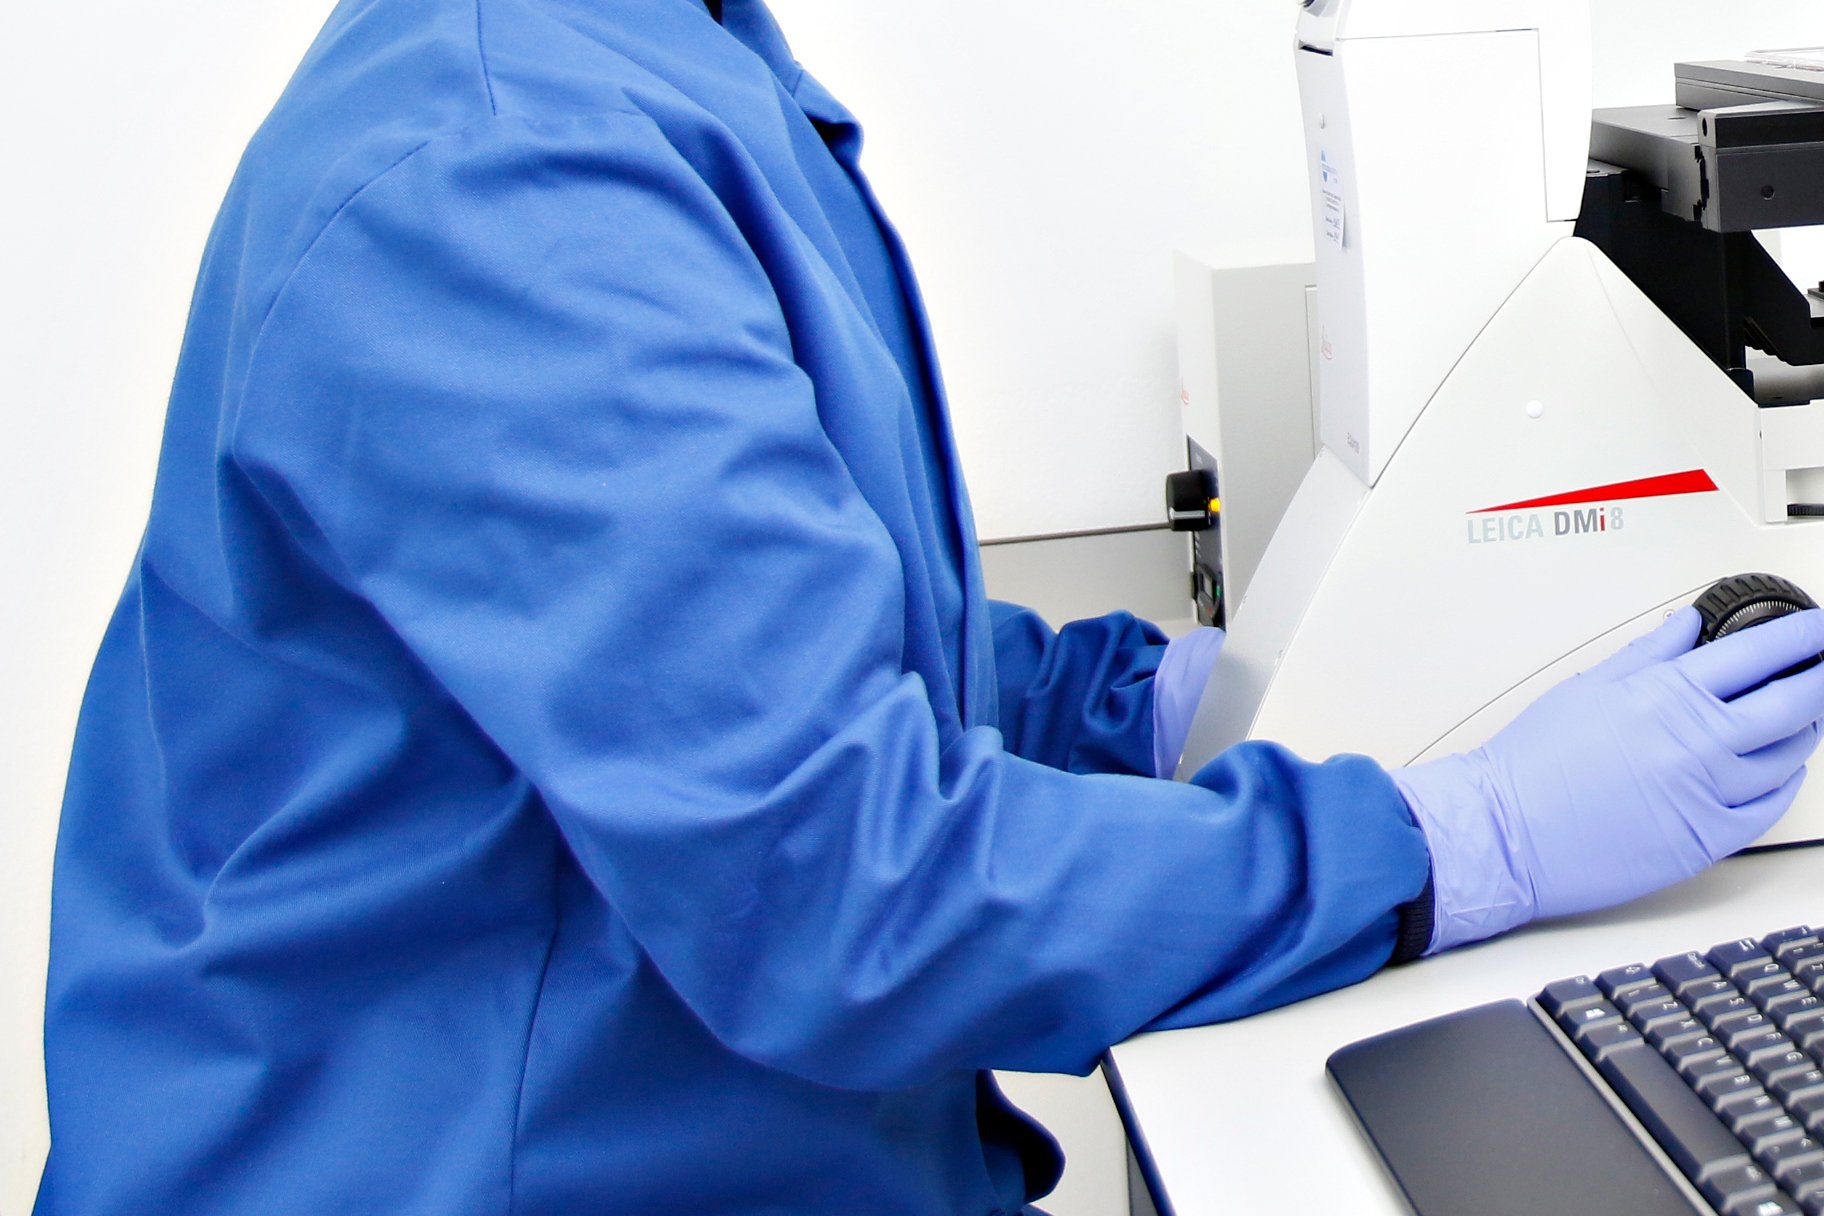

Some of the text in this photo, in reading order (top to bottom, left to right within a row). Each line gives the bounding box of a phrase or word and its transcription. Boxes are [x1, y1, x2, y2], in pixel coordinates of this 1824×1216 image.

[1467, 506, 1624, 544] LEICA DMi8
[1680, 1018, 1697, 1028] X
[1697, 1036, 1714, 1046] C
